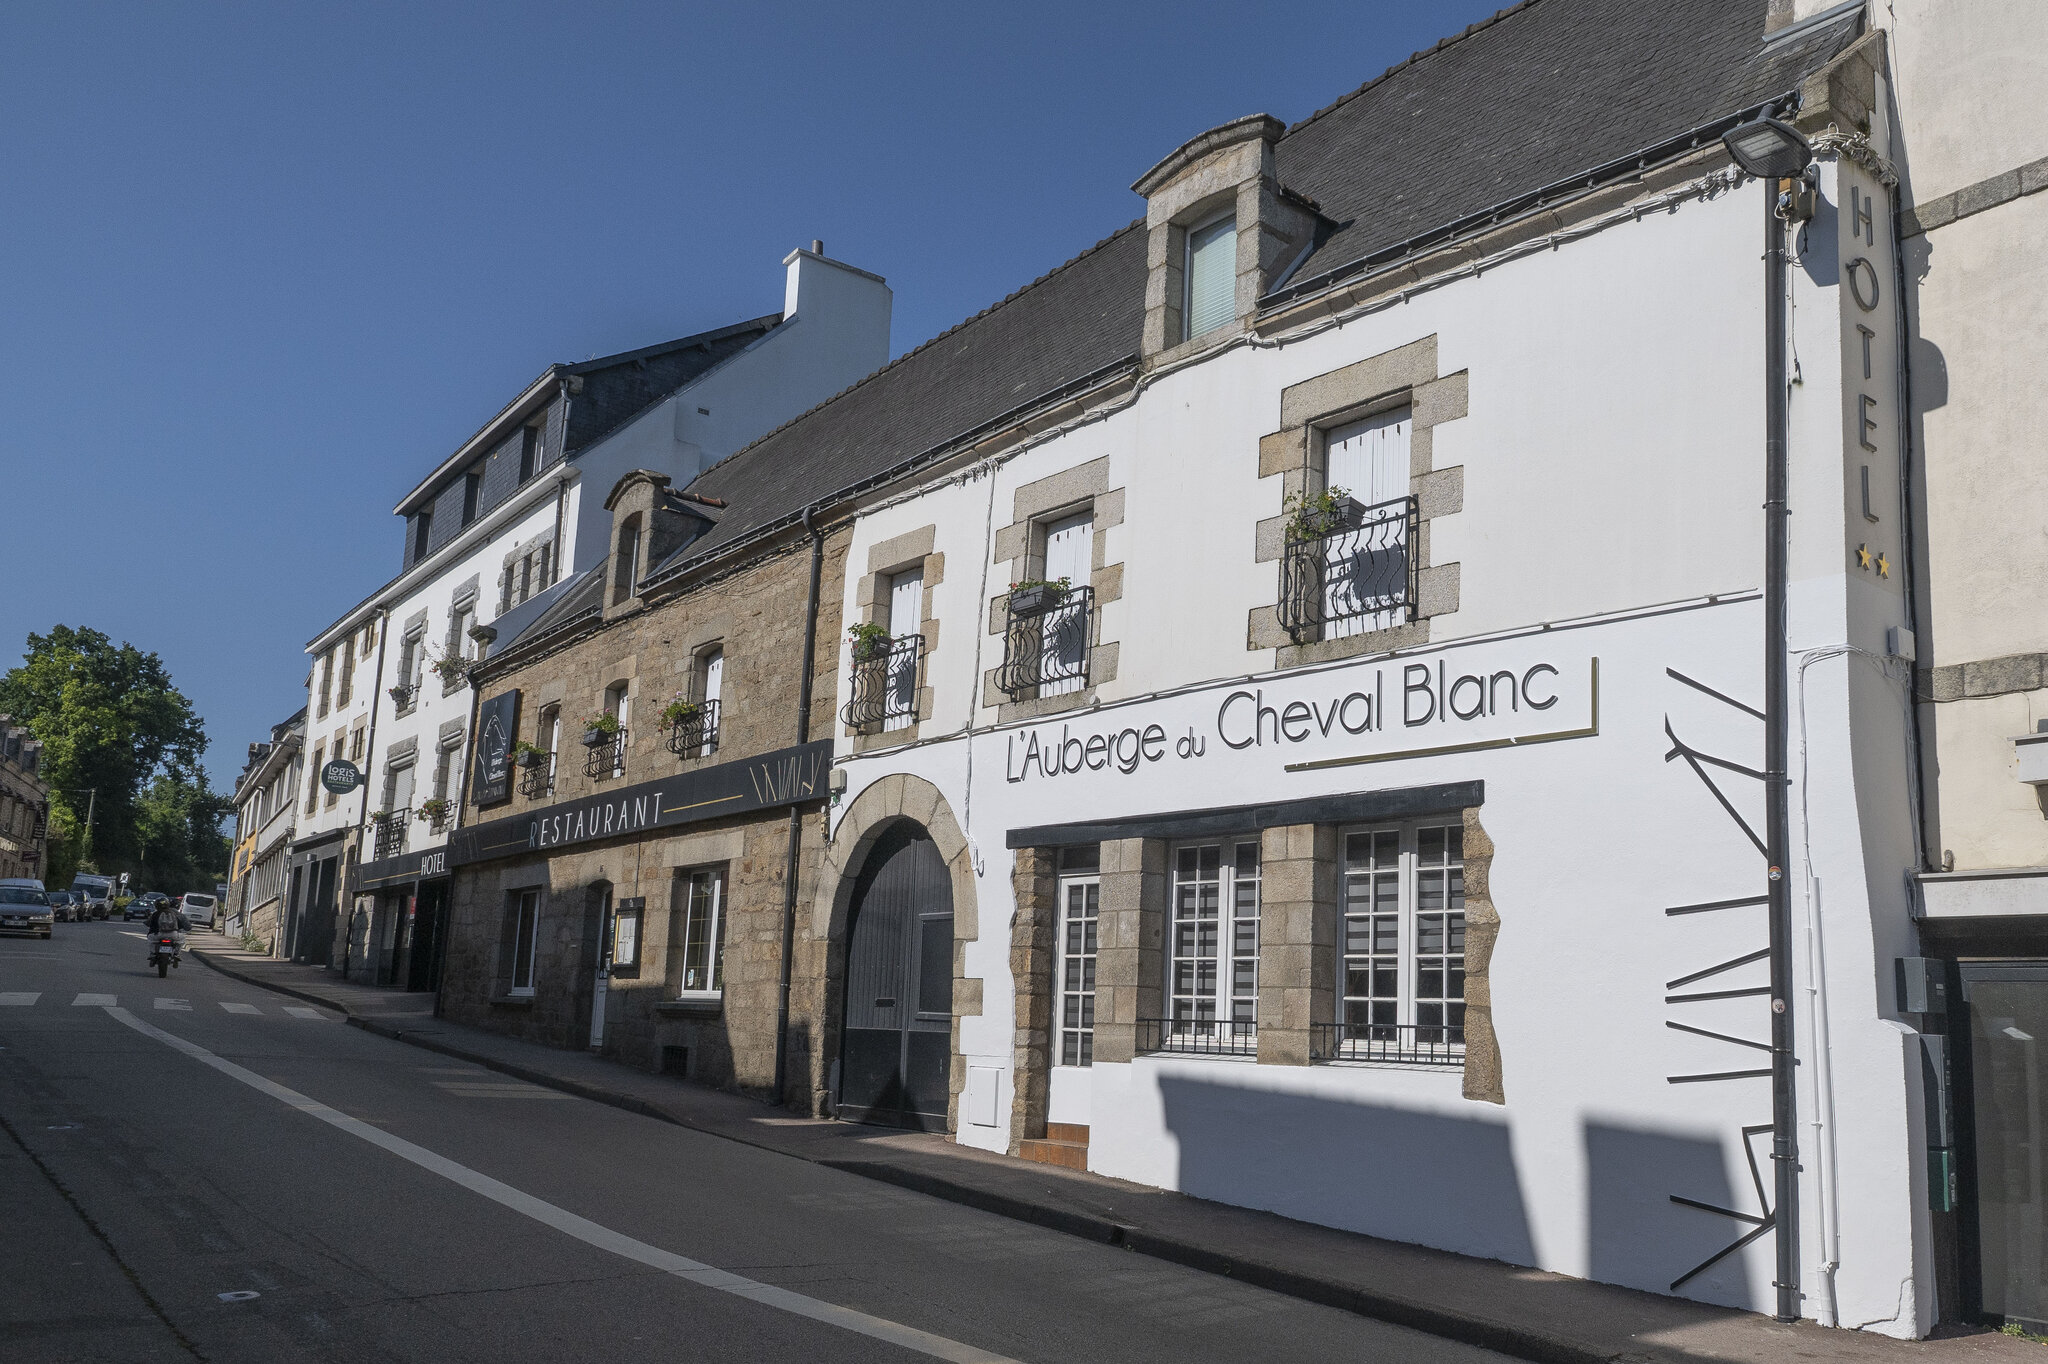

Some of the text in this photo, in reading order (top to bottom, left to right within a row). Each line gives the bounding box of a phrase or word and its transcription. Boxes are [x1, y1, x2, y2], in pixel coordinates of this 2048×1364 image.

[1849, 184, 1880, 524] HOTEL
[1005, 659, 1560, 783] L'Auberge du Cheval Blanc
[420, 852, 446, 876] HOTEL
[529, 792, 663, 848] RESTAURANT
